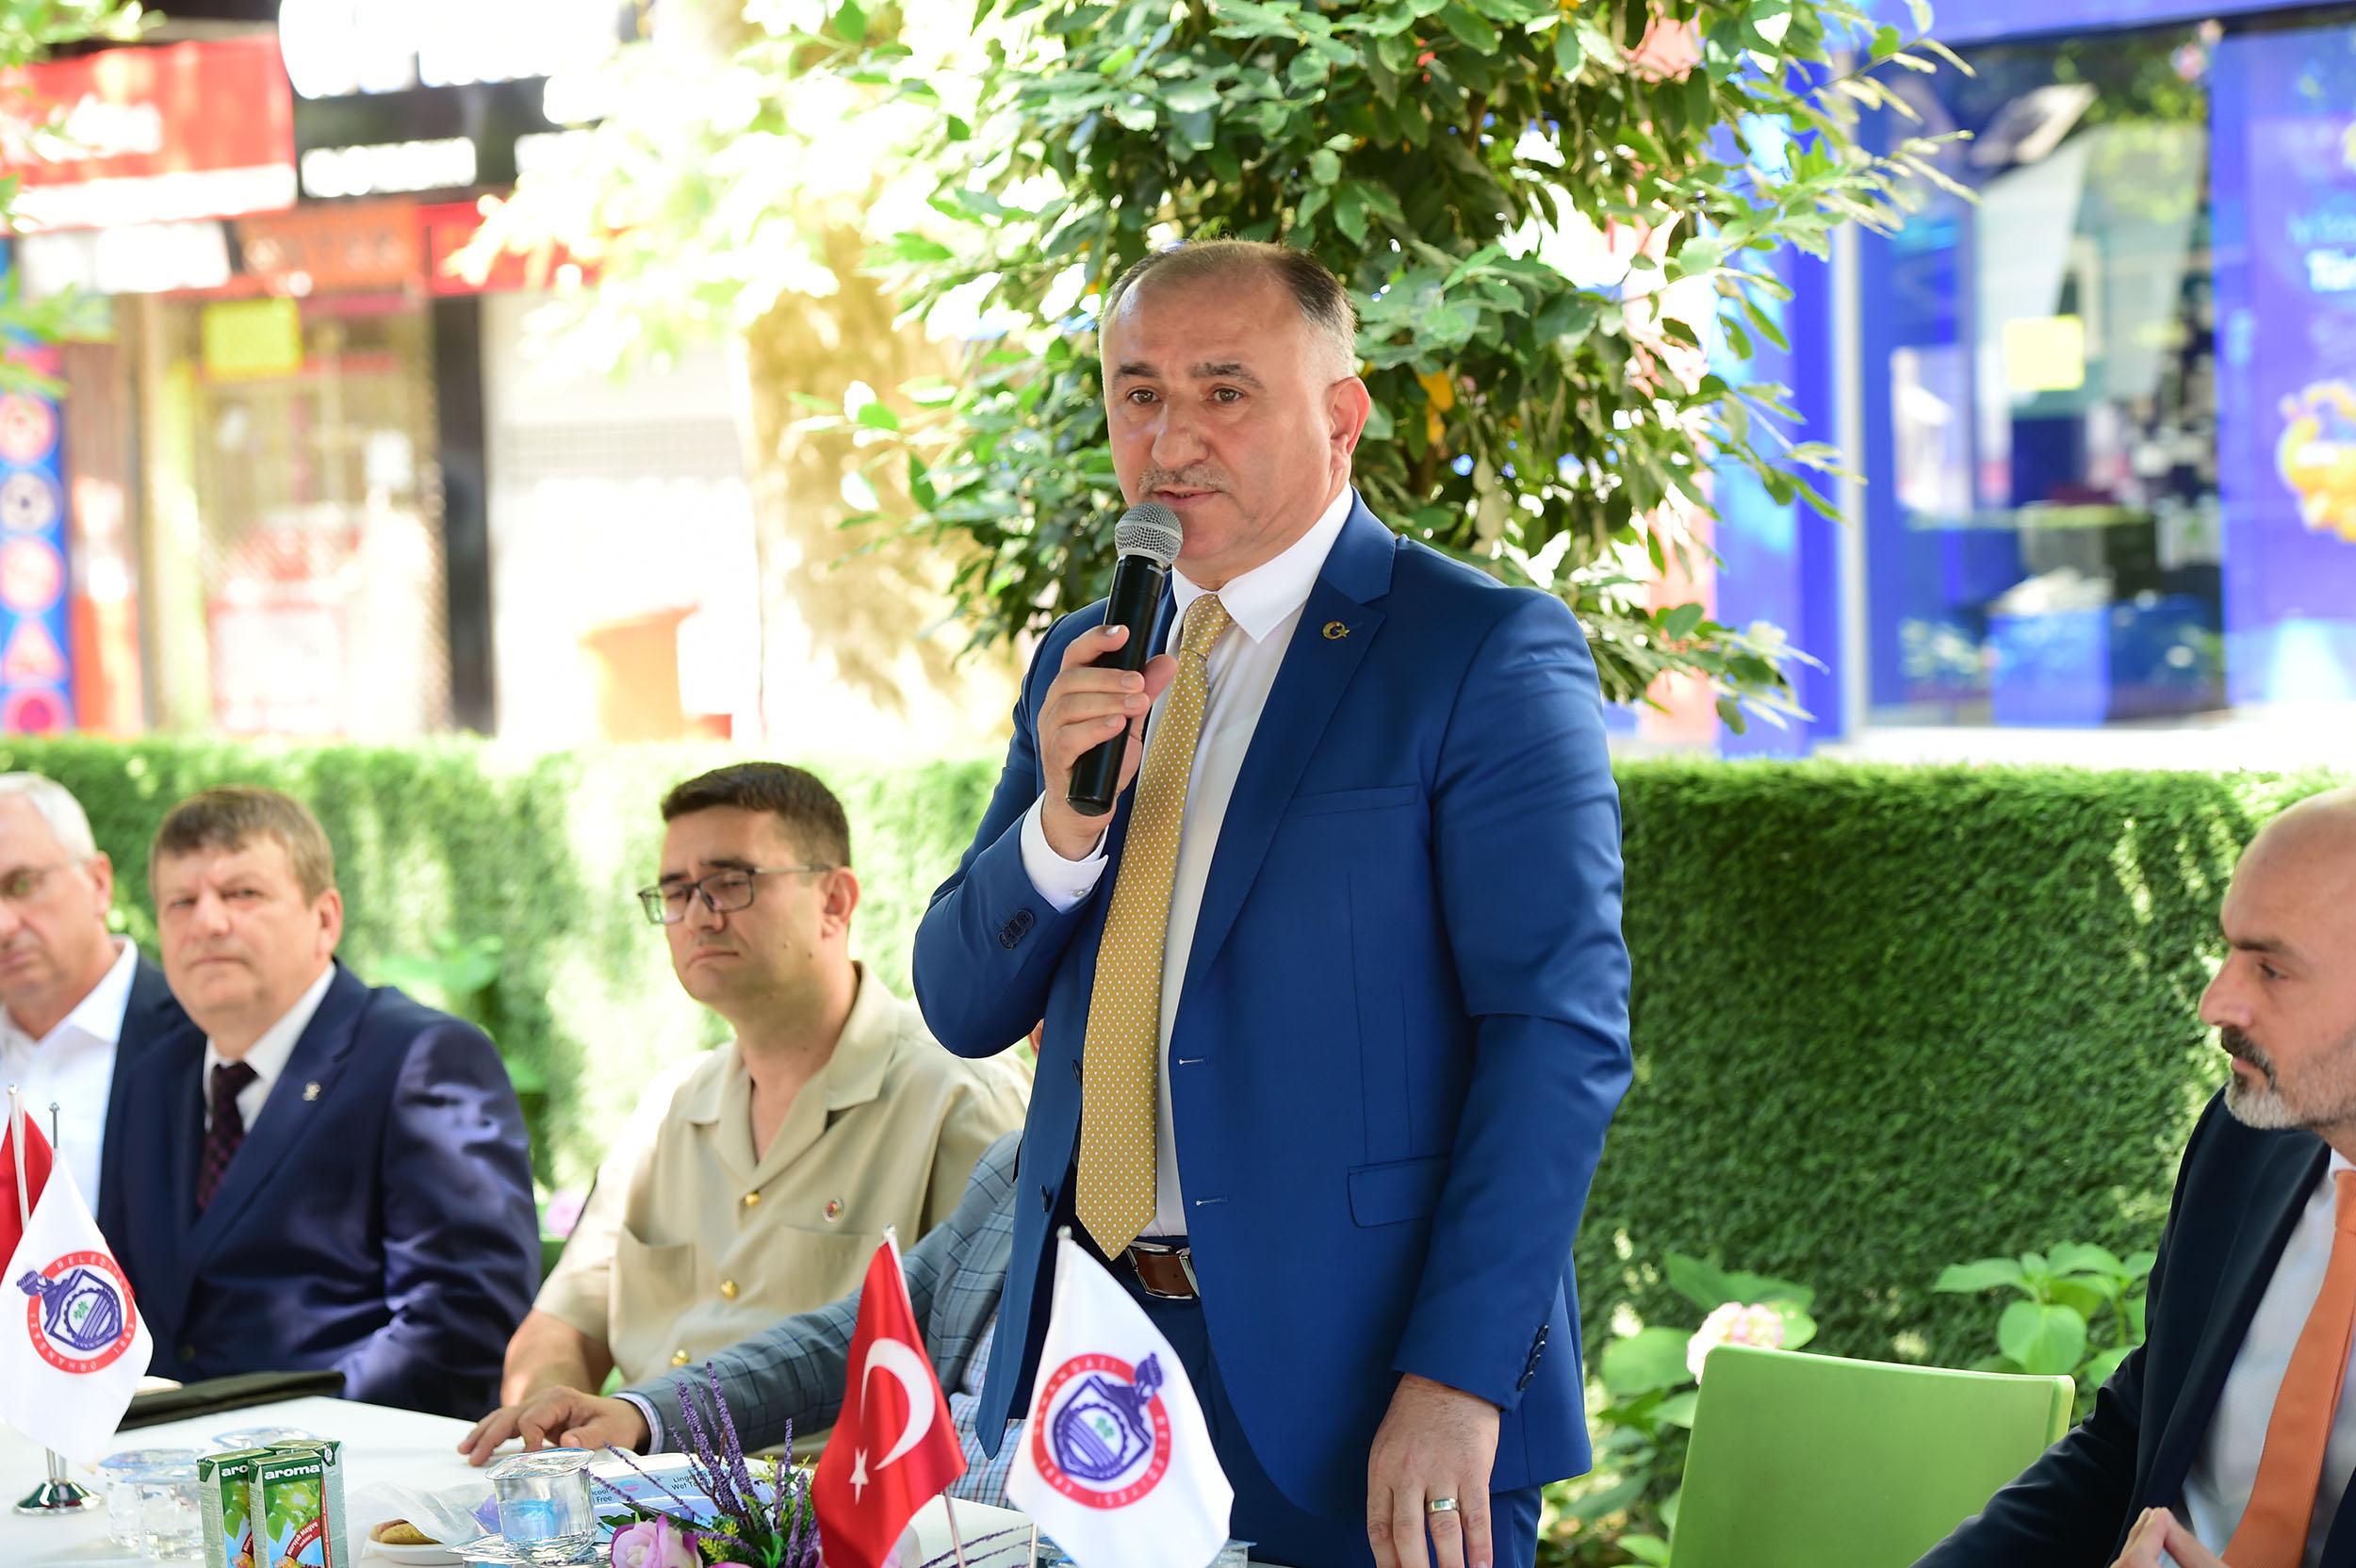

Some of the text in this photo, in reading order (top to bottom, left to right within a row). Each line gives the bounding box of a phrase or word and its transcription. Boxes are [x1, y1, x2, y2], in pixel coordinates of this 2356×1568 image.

[221, 1465, 249, 1478] aro
[264, 1464, 320, 1480] aroma
[671, 1481, 687, 1491] Wet
